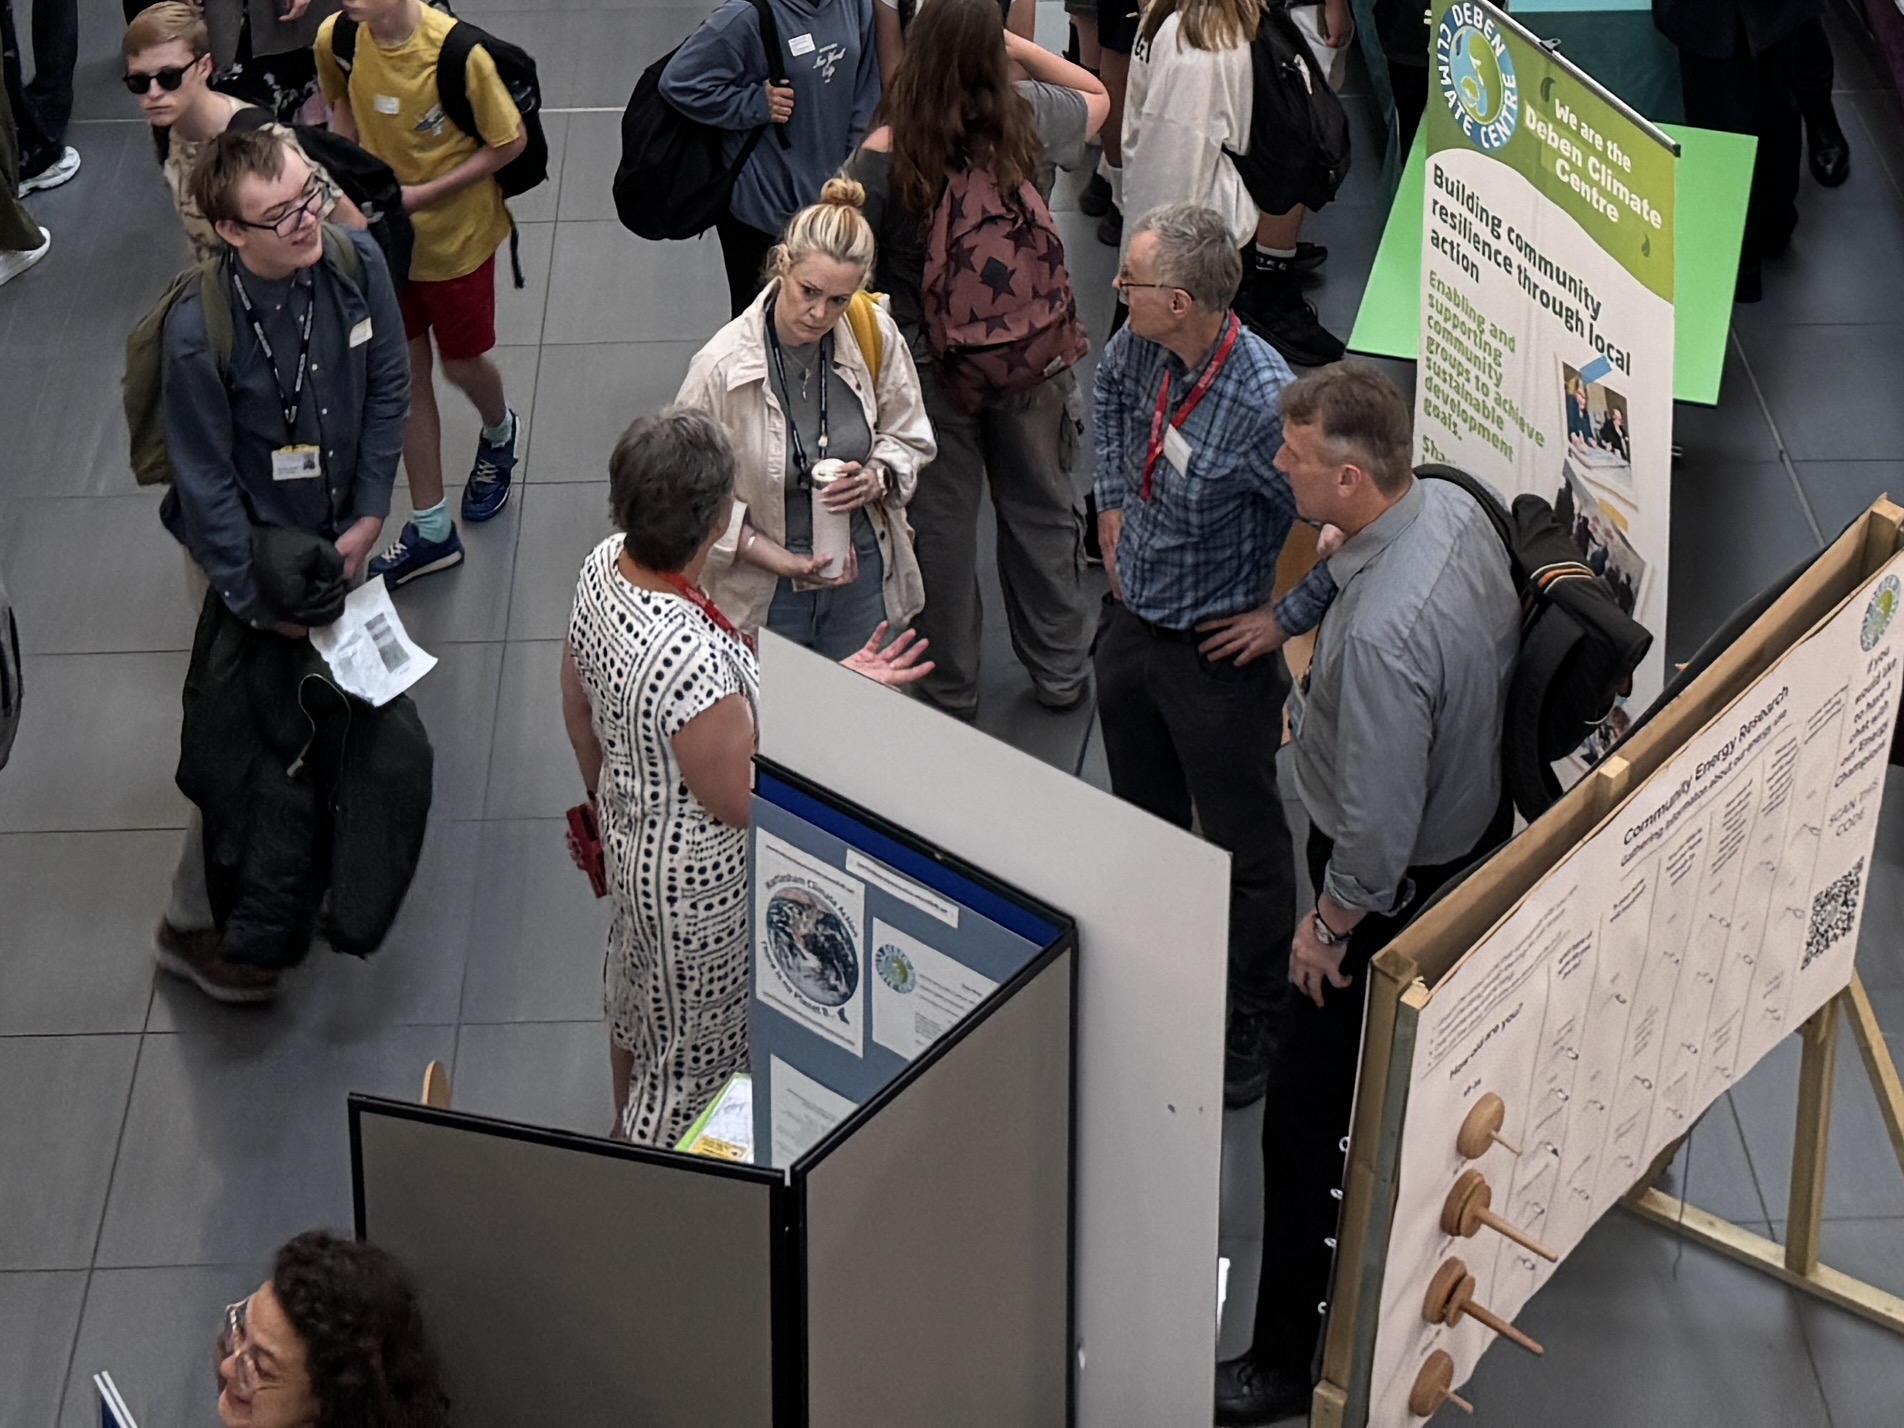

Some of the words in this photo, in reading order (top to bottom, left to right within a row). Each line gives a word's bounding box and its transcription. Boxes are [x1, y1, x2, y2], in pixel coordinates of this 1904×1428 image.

[1452, 3, 1506, 57] DEBEN
[1438, 26, 1472, 137] CLIMATE
[1480, 75, 1516, 149] CENTRE
[1525, 107, 1583, 167] Deben
[1588, 156, 1662, 230] Climate
[1555, 99, 1578, 128] We
[1581, 123, 1605, 150] are
[1606, 139, 1632, 173] the
[1555, 159, 1620, 223] Centre
[1431, 228, 1479, 284] action
[1433, 164, 1502, 241] Building
[1507, 226, 1602, 321] community
[1429, 270, 1486, 328] Enabling
[1490, 320, 1516, 354] and
[1432, 198, 1513, 274] resilience
[1518, 263, 1585, 339] through
[1589, 321, 1631, 377] local
[1427, 316, 1503, 388] community
[1428, 293, 1503, 368] supporting
[1424, 397, 1462, 441] goals.
[1425, 356, 1505, 431] sustainable
[1425, 375, 1514, 464] development
[1426, 335, 1471, 391] groups
[1475, 374, 1490, 398] to
[1494, 391, 1545, 447] achieve
[1624, 775, 1692, 845] Community
[1695, 736, 1736, 781] Energy
[1738, 686, 1789, 743] Research
